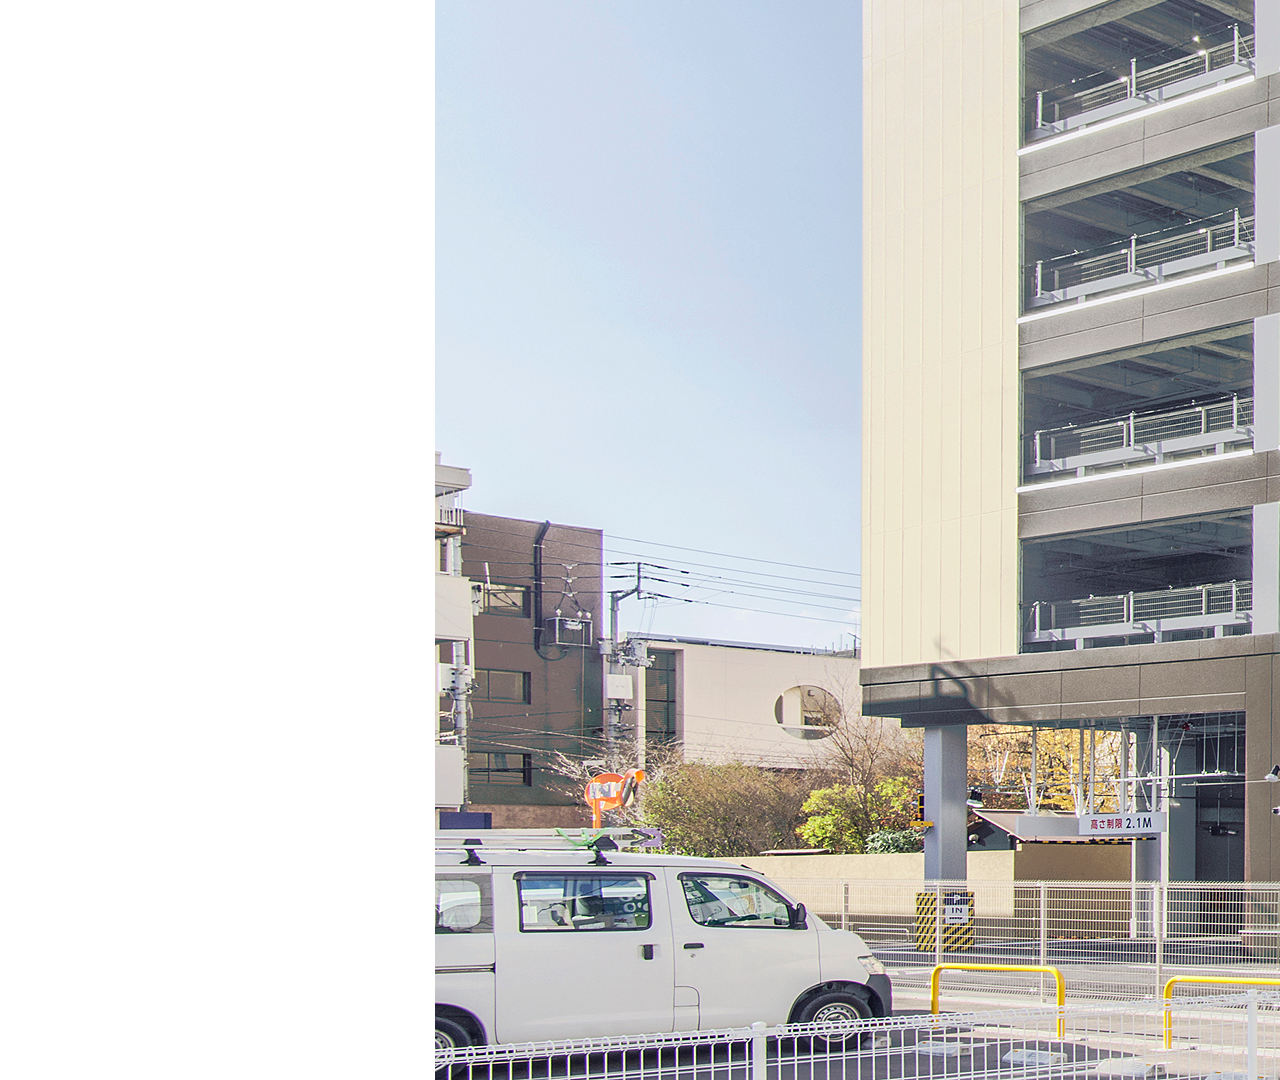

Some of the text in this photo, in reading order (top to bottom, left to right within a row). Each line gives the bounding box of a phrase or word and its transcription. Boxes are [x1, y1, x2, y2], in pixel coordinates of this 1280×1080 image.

[1090, 817, 1152, 830] 高さ制限 2.1M
